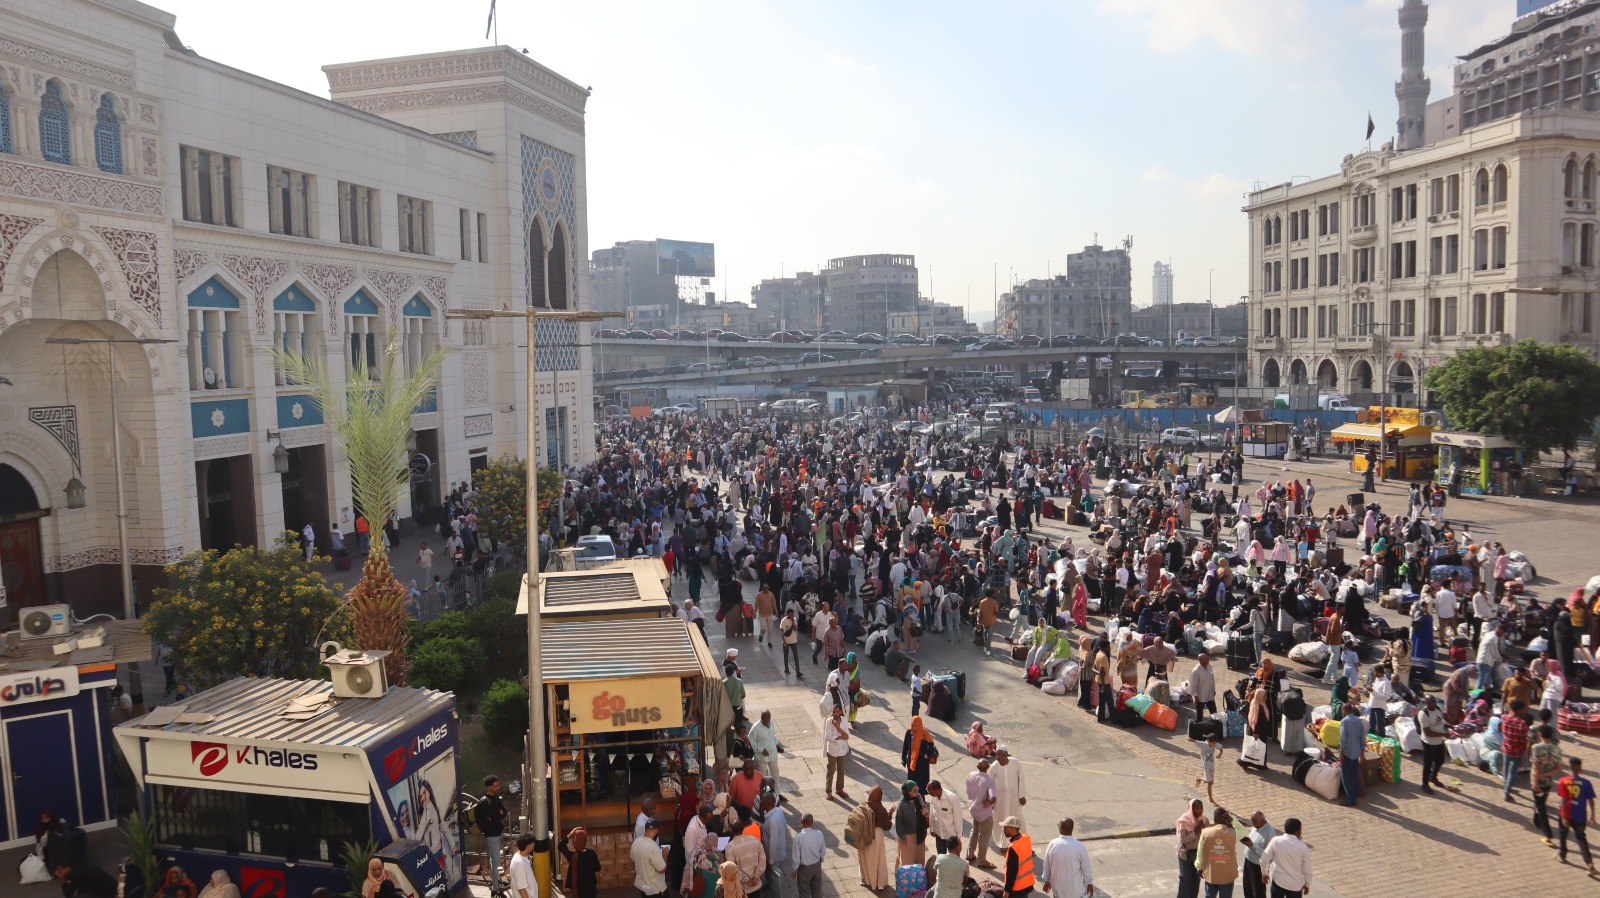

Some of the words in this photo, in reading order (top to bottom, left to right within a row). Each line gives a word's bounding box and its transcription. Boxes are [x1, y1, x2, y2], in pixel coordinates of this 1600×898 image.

[592, 691, 626, 721] go
[611, 706, 662, 727] nuts
[409, 723, 448, 759] Khales
[236, 745, 318, 771] Khales
